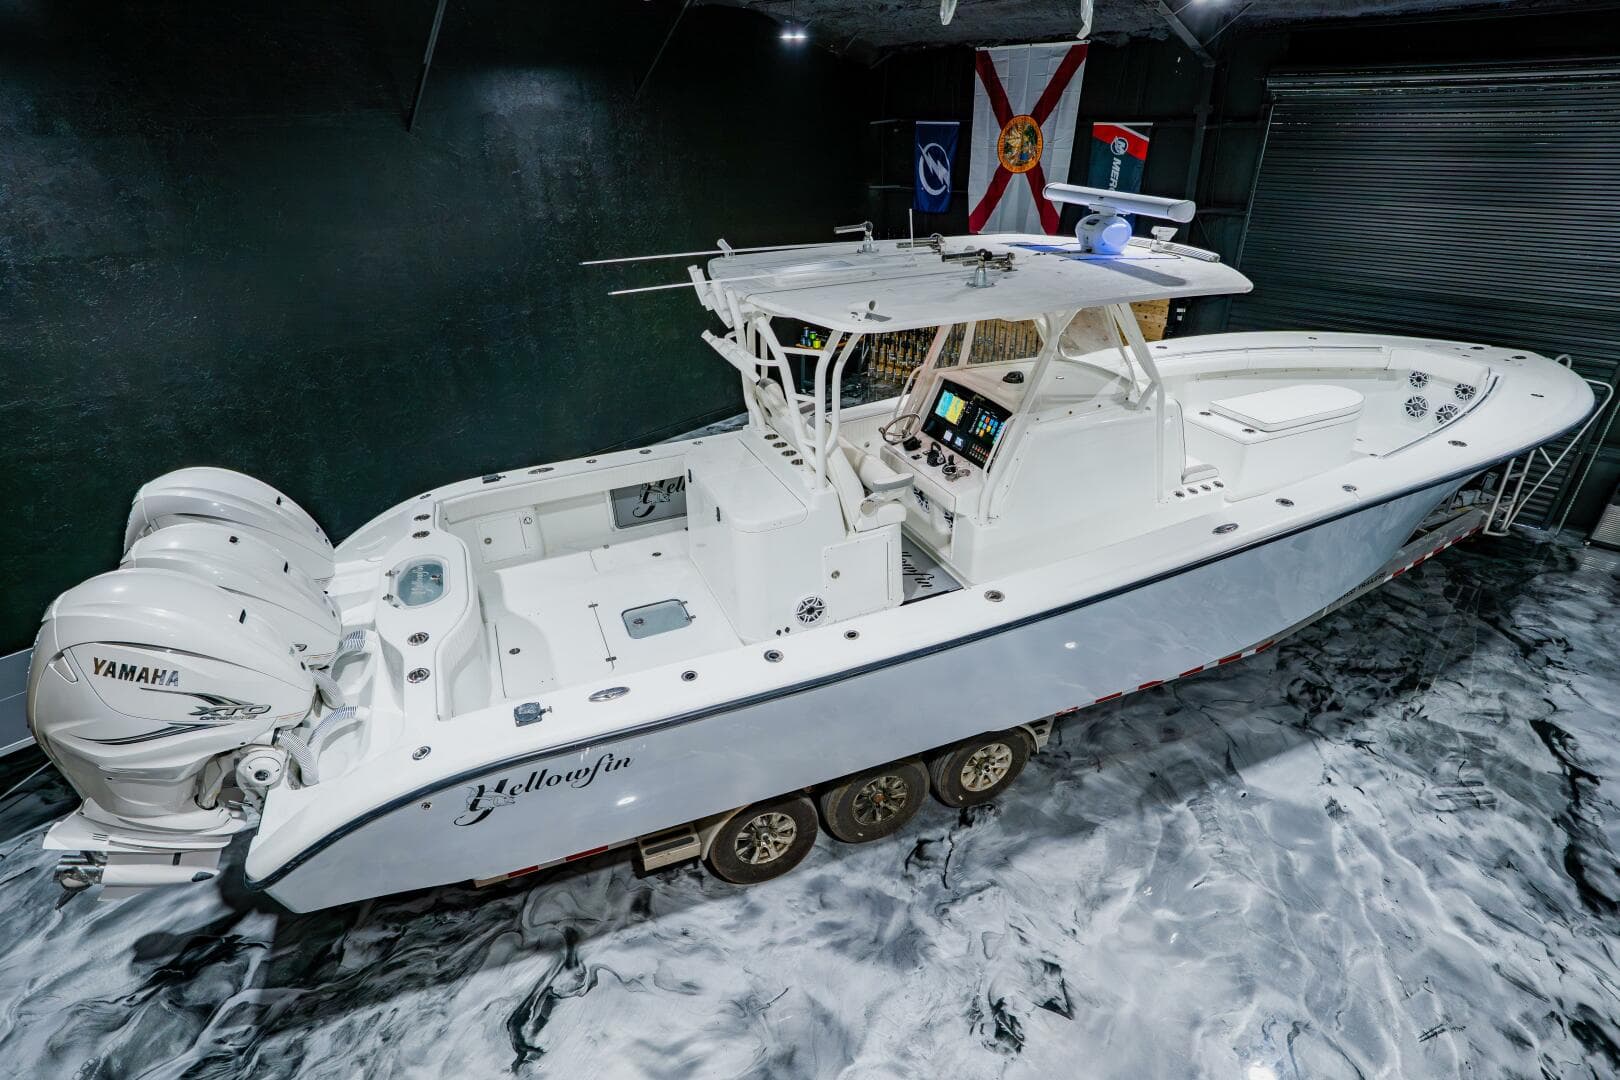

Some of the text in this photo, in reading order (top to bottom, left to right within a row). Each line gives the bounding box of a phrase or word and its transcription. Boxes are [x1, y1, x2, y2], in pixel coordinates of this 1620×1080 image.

[93, 656, 180, 688] YAMAHA
[188, 704, 272, 717] XTO
[453, 753, 632, 827] Yellowfin
